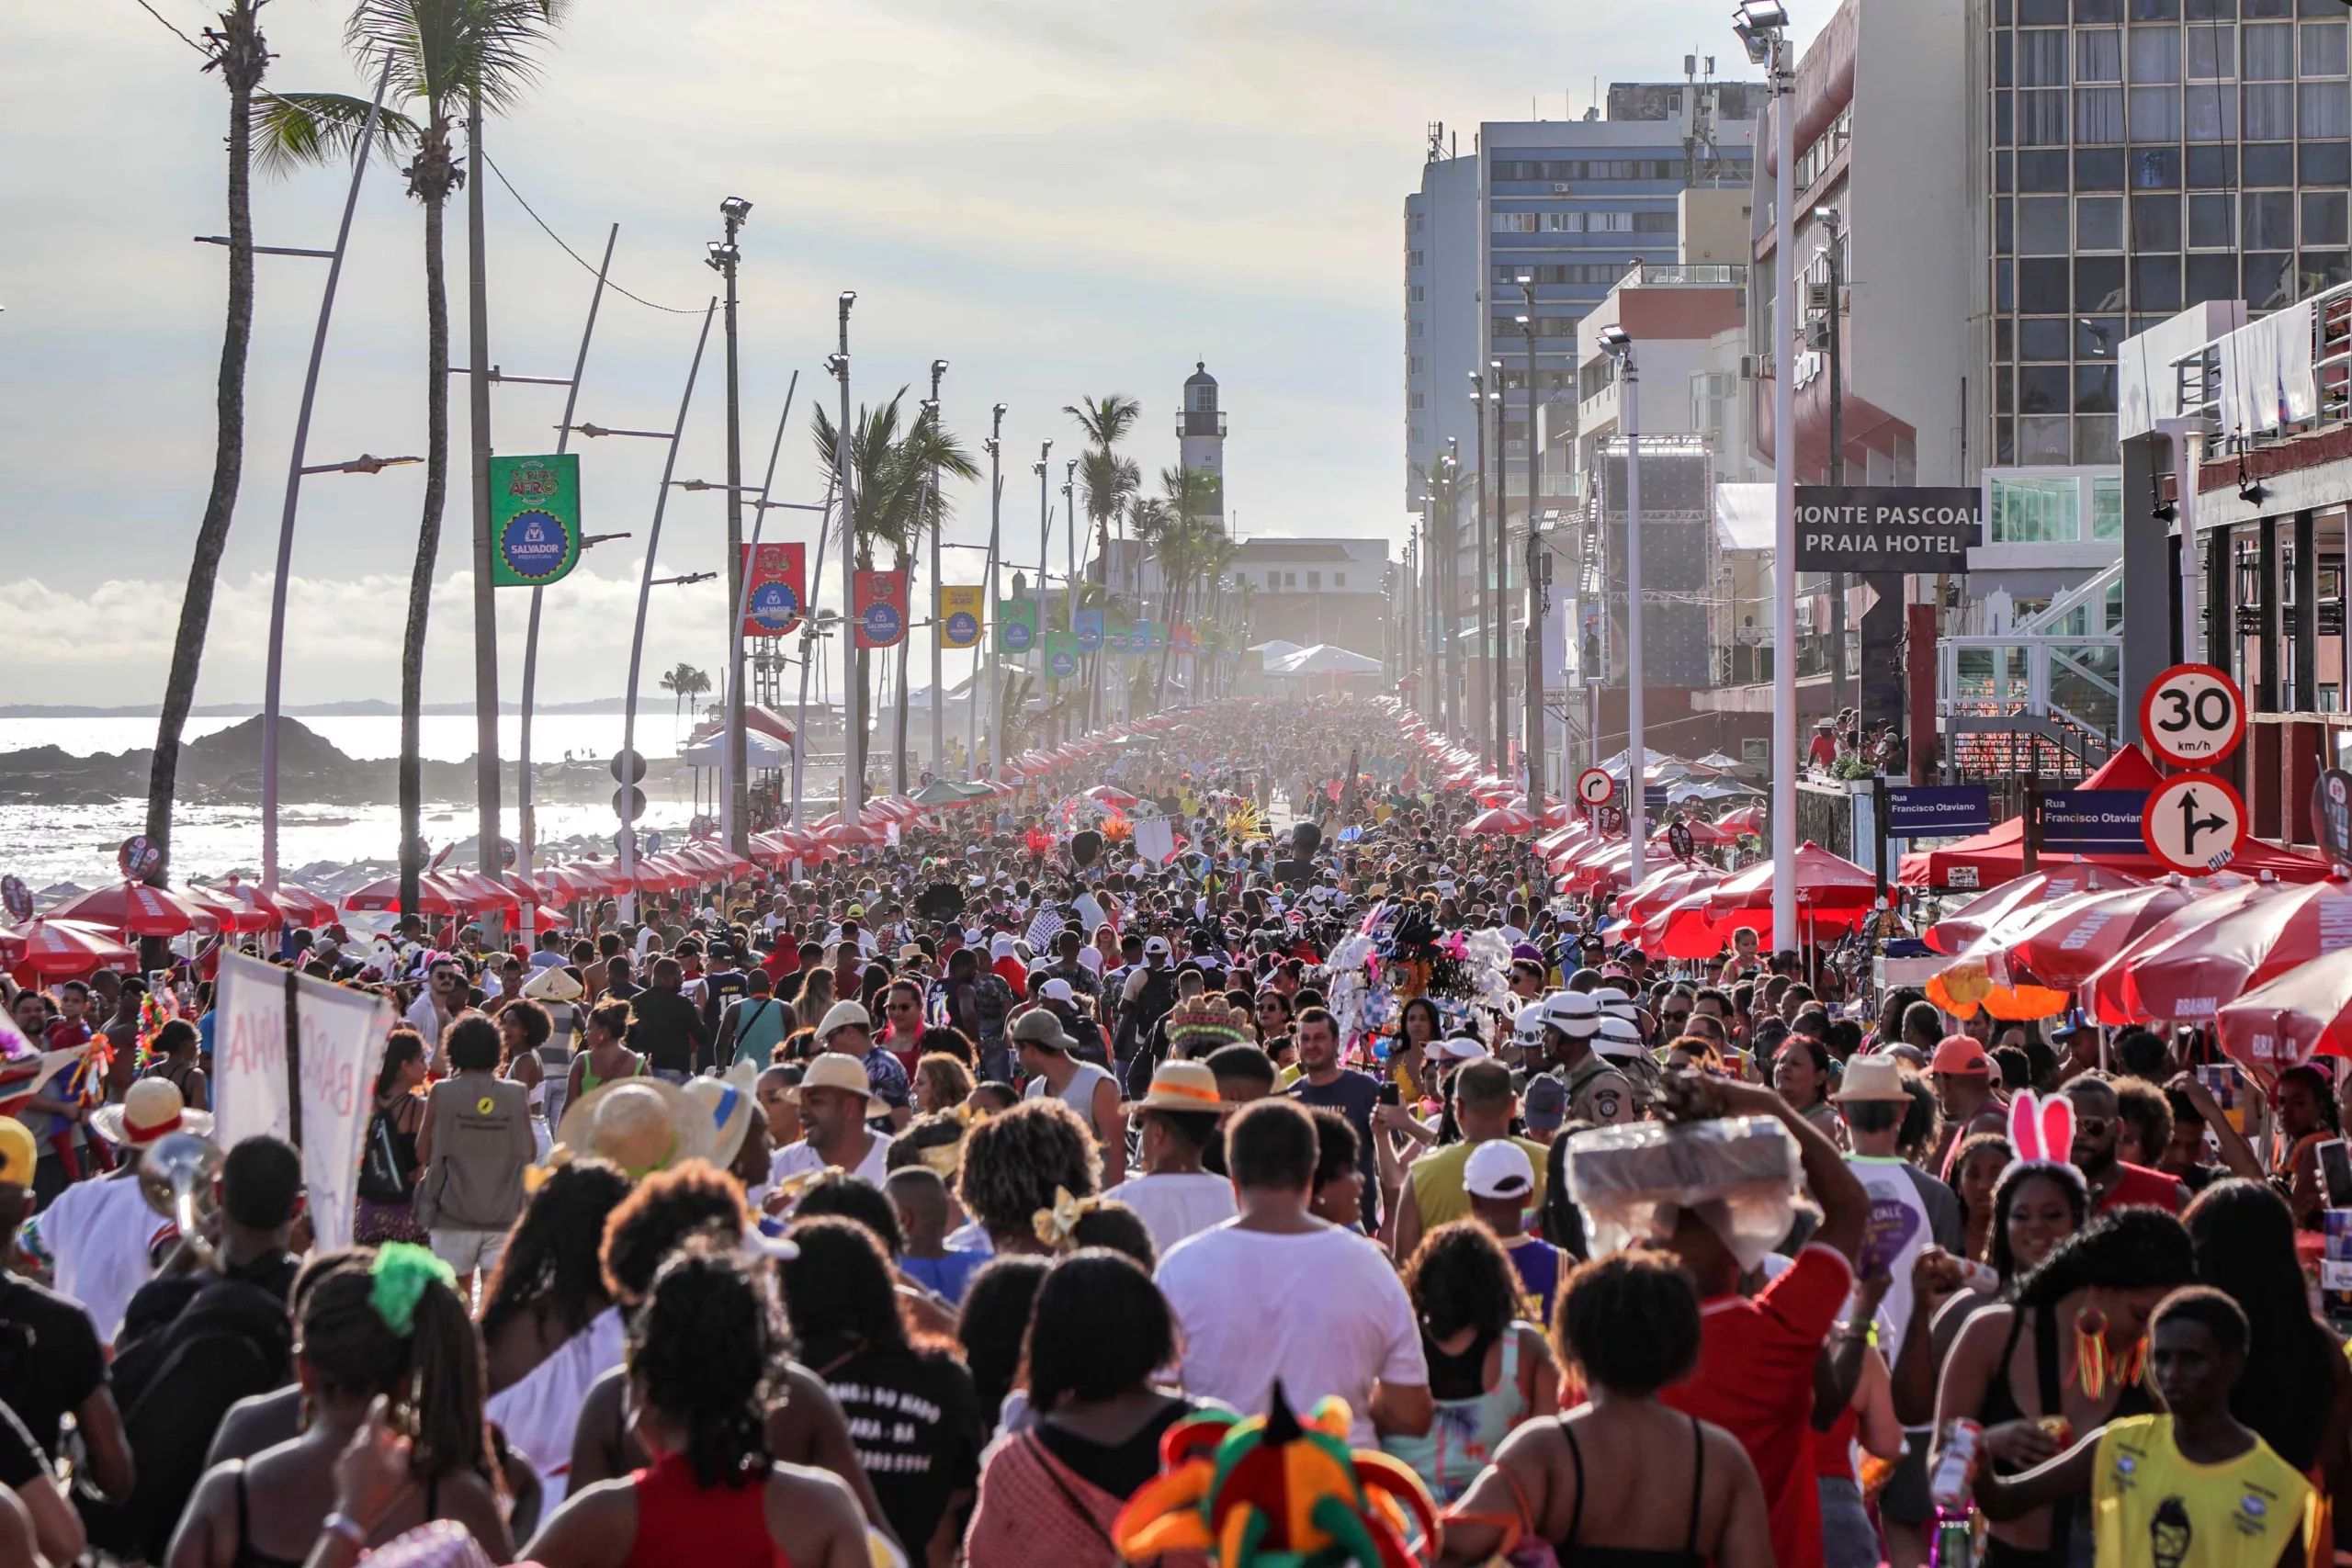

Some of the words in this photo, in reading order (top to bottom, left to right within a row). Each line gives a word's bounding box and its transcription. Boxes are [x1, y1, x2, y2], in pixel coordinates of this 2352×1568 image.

[511, 480, 557, 495] AFRO
[1876, 507, 1983, 525] PASCOAL
[511, 544, 559, 554] SALVADOR
[1805, 535, 1878, 551] PRAIA
[1886, 536, 1960, 553] HOTEL
[2158, 688, 2231, 732] 30
[2177, 740, 2211, 751] km/h
[1892, 804, 1935, 813] Francisco
[1936, 803, 1975, 811] Otaviano
[2045, 798, 2066, 808] Rua
[2045, 813, 2098, 822] Francisco
[2101, 813, 2143, 822] Otavian
[2175, 997, 2217, 1016] BRAHMA
